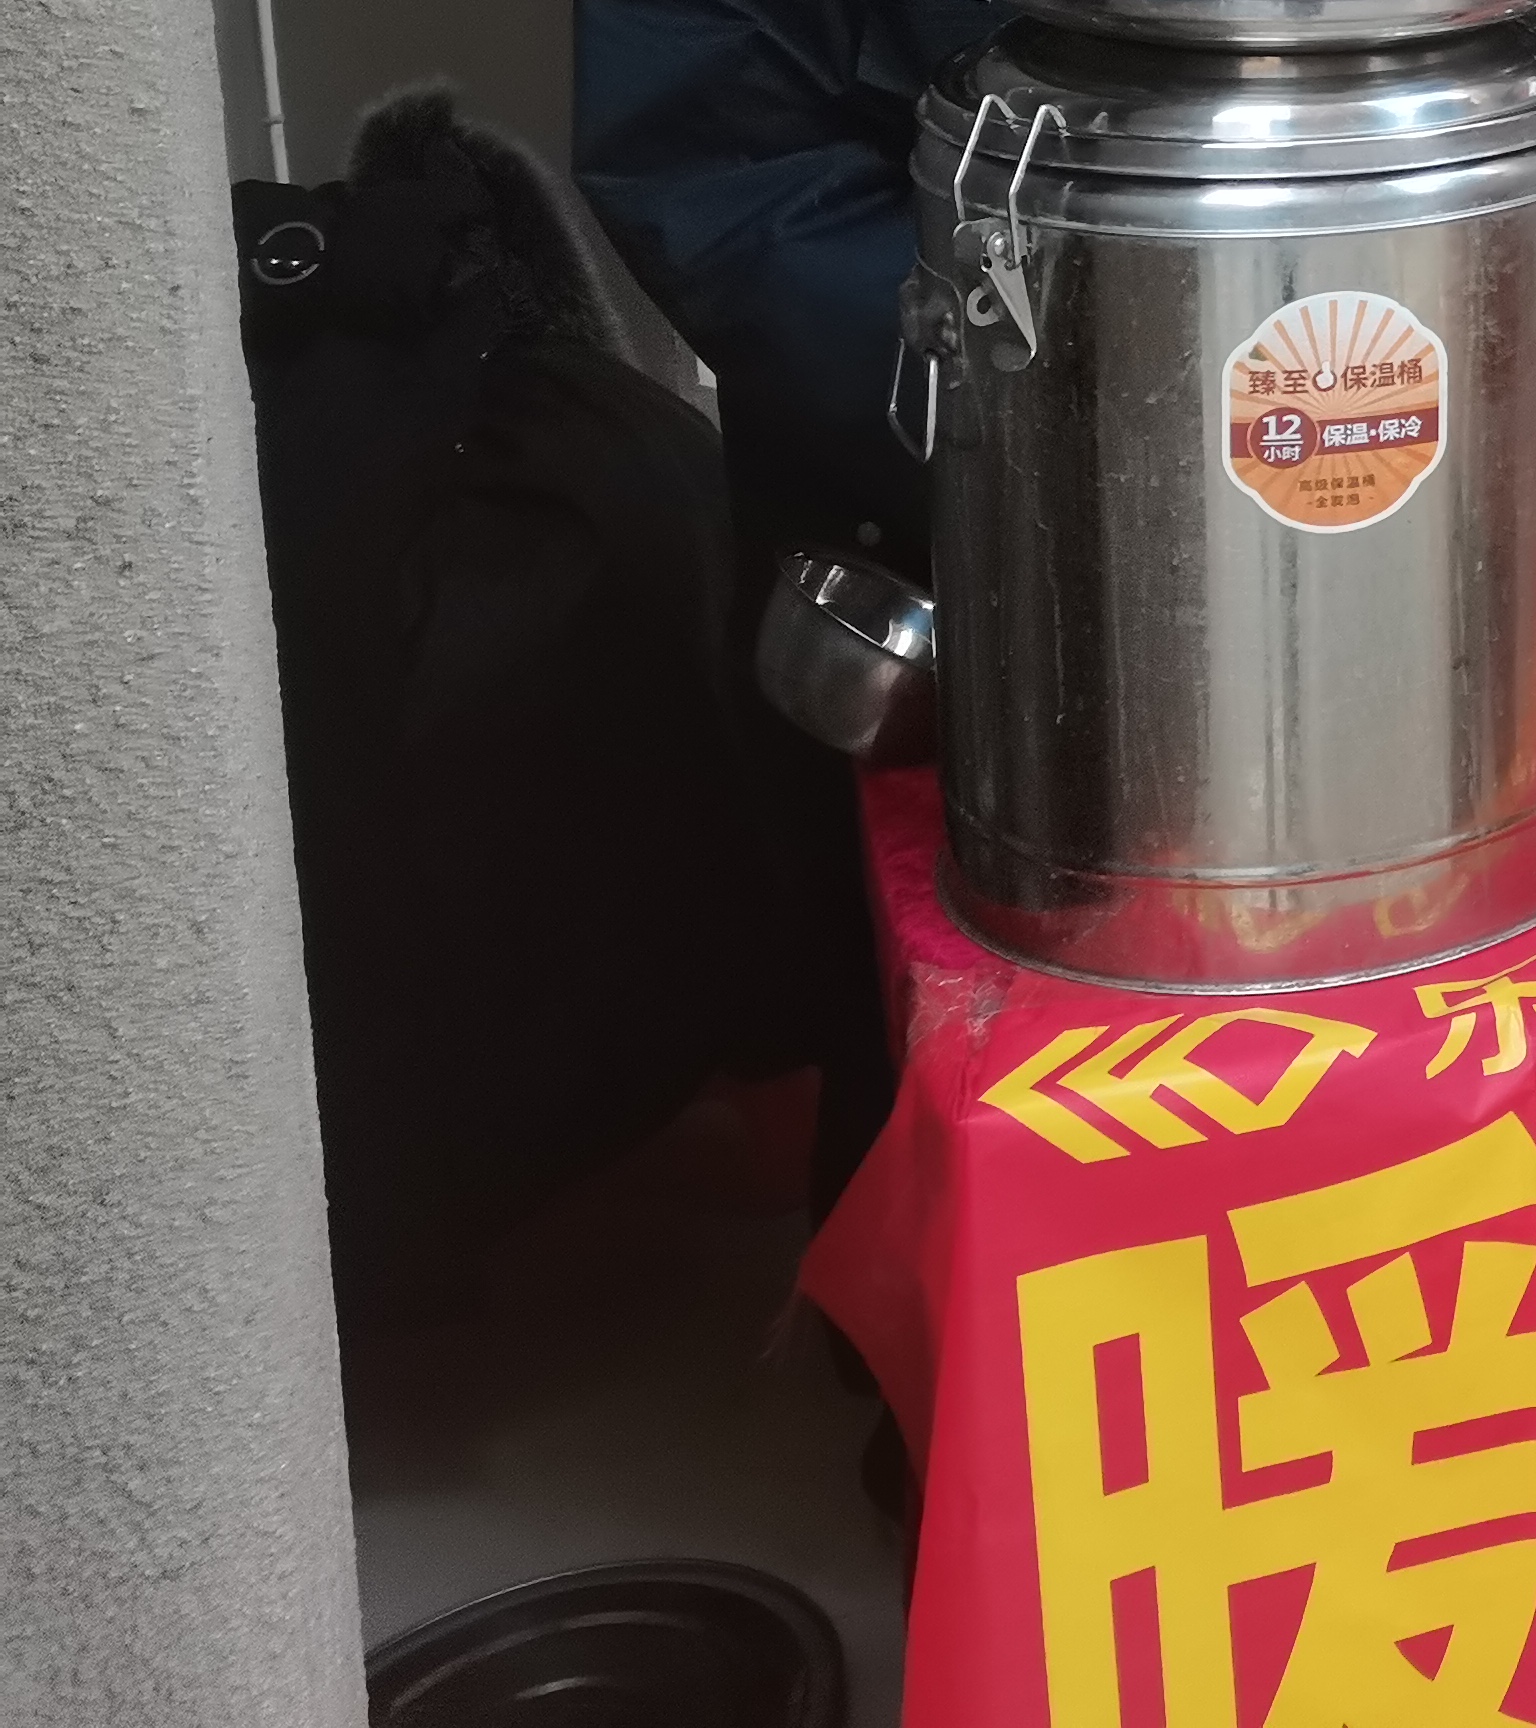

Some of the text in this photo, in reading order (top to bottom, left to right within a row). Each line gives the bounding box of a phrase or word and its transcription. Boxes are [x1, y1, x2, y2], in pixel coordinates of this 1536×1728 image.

[1248, 358, 1423, 396] 臻至 保温桶
[1261, 414, 1302, 440] 12
[1263, 445, 1301, 463] 小时
